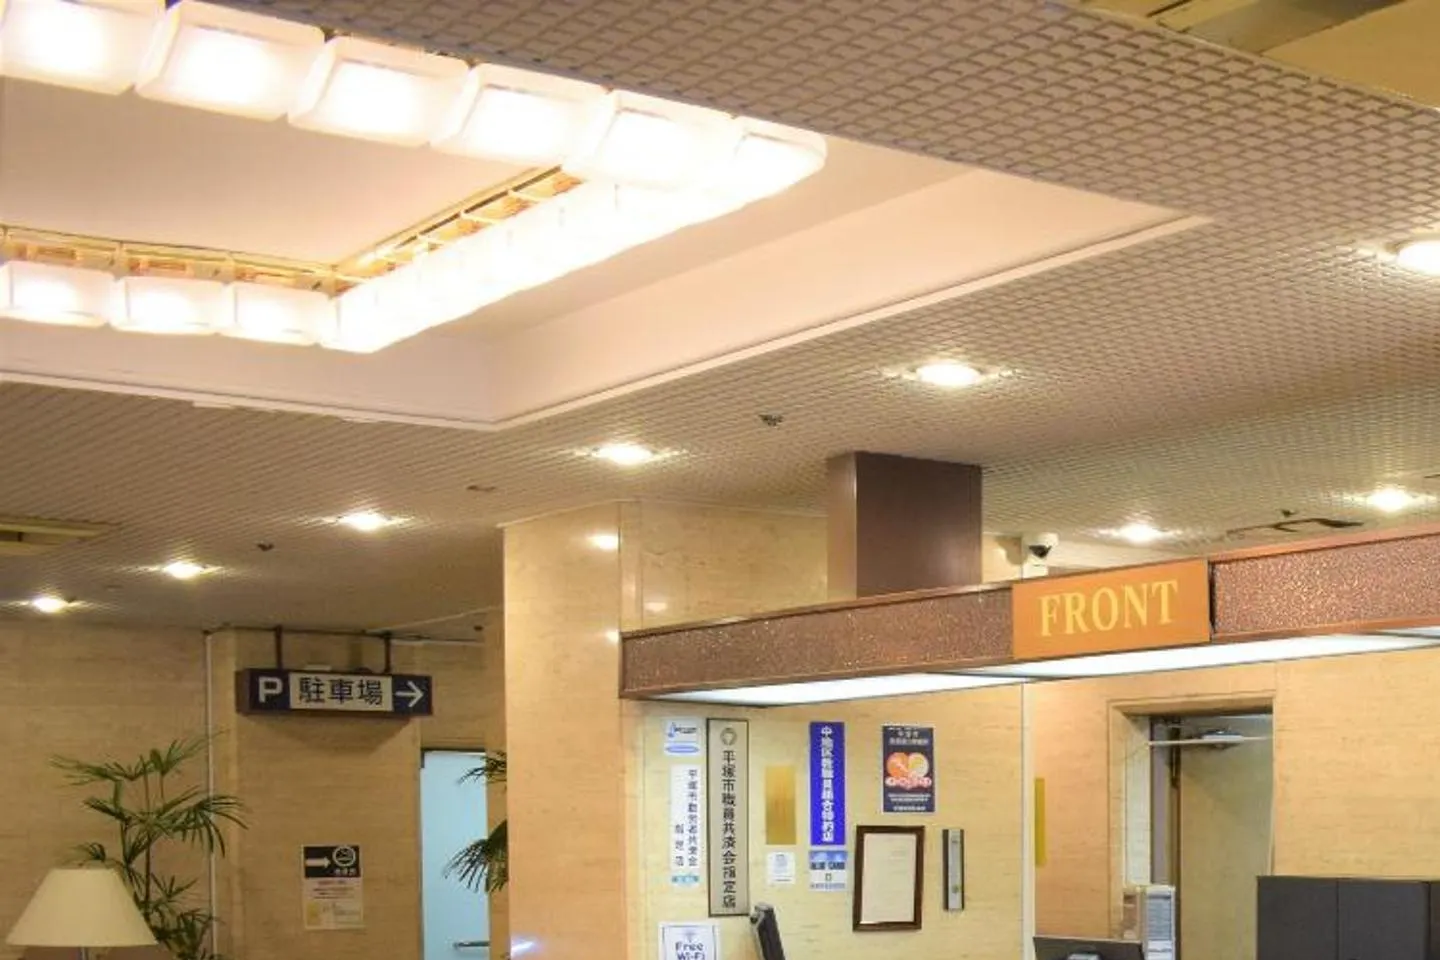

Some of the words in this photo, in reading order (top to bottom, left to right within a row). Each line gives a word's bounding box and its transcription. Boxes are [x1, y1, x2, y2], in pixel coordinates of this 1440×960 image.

[1039, 580, 1179, 637] FRONT
[258, 676, 283, 703] P
[298, 677, 383, 705] 駐車場
[721, 750, 737, 909] 平塚市職員共済会指定店
[675, 942, 704, 952] Free
